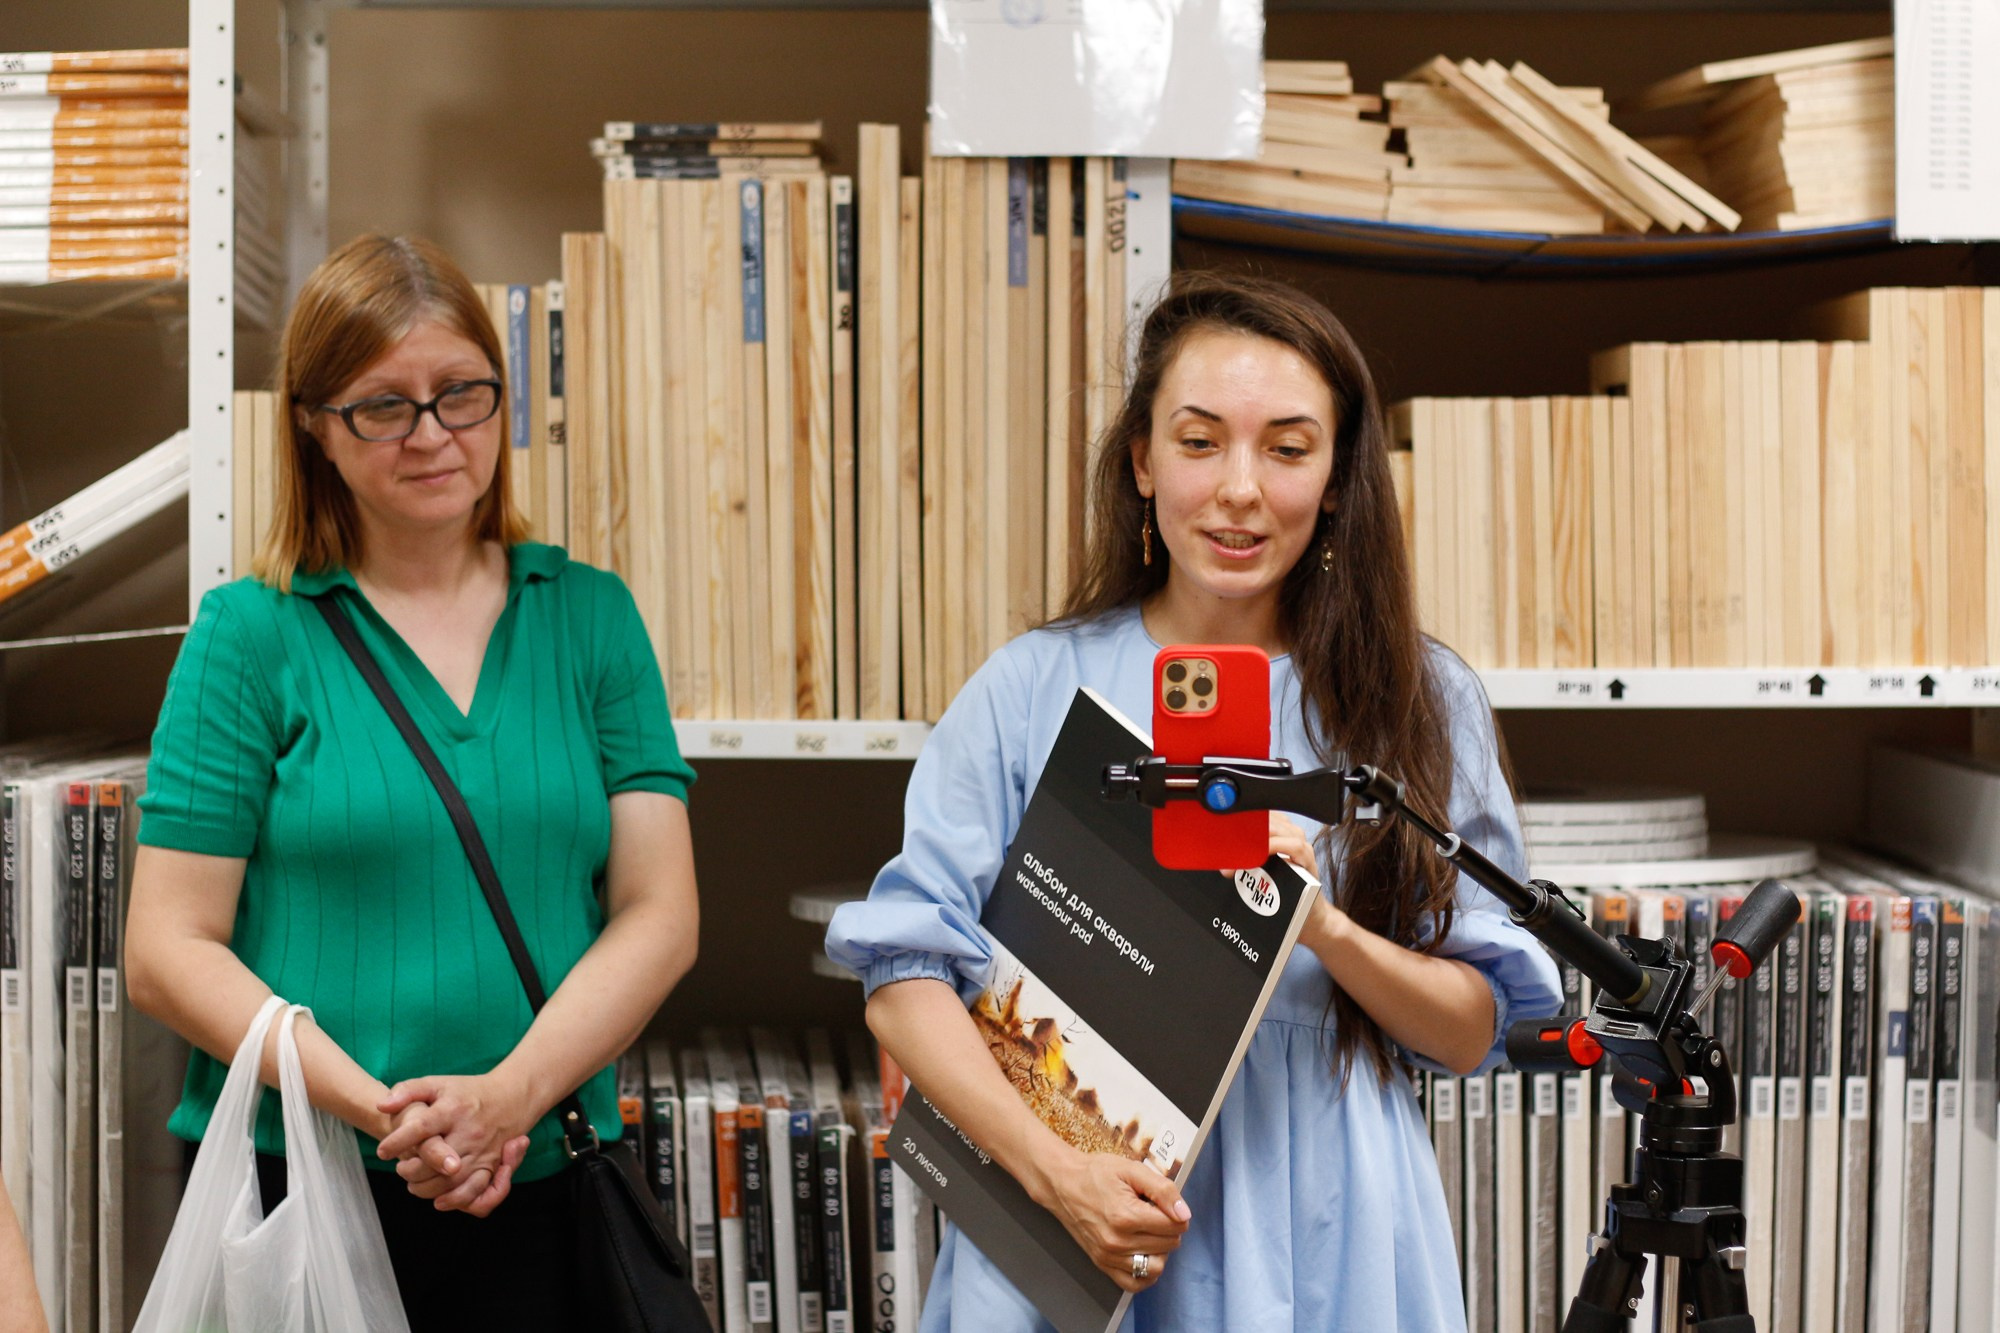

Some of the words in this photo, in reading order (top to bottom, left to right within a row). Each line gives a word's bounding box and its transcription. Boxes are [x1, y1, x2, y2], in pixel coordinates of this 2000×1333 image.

[1106, 194, 1127, 253] 1200
[104, 787, 116, 799] T
[71, 815, 84, 841] 100
[102, 816, 115, 842] 100
[71, 854, 84, 879] 120
[102, 854, 115, 880] 120
[1016, 870, 1072, 926] watercolour
[1070, 921, 1093, 945] pad
[1023, 852, 1068, 898] альбом
[1066, 893, 1093, 921] для
[1094, 916, 1155, 976] акварели
[1220, 921, 1241, 944] 1899
[1237, 939, 1260, 963] года
[657, 1104, 671, 1119] T
[793, 1117, 809, 1132] T
[823, 1132, 838, 1147] T
[902, 1137, 917, 1154] 20
[915, 1152, 948, 1188] листов
[823, 1167, 839, 1186] 80
[825, 1198, 840, 1217] 80
